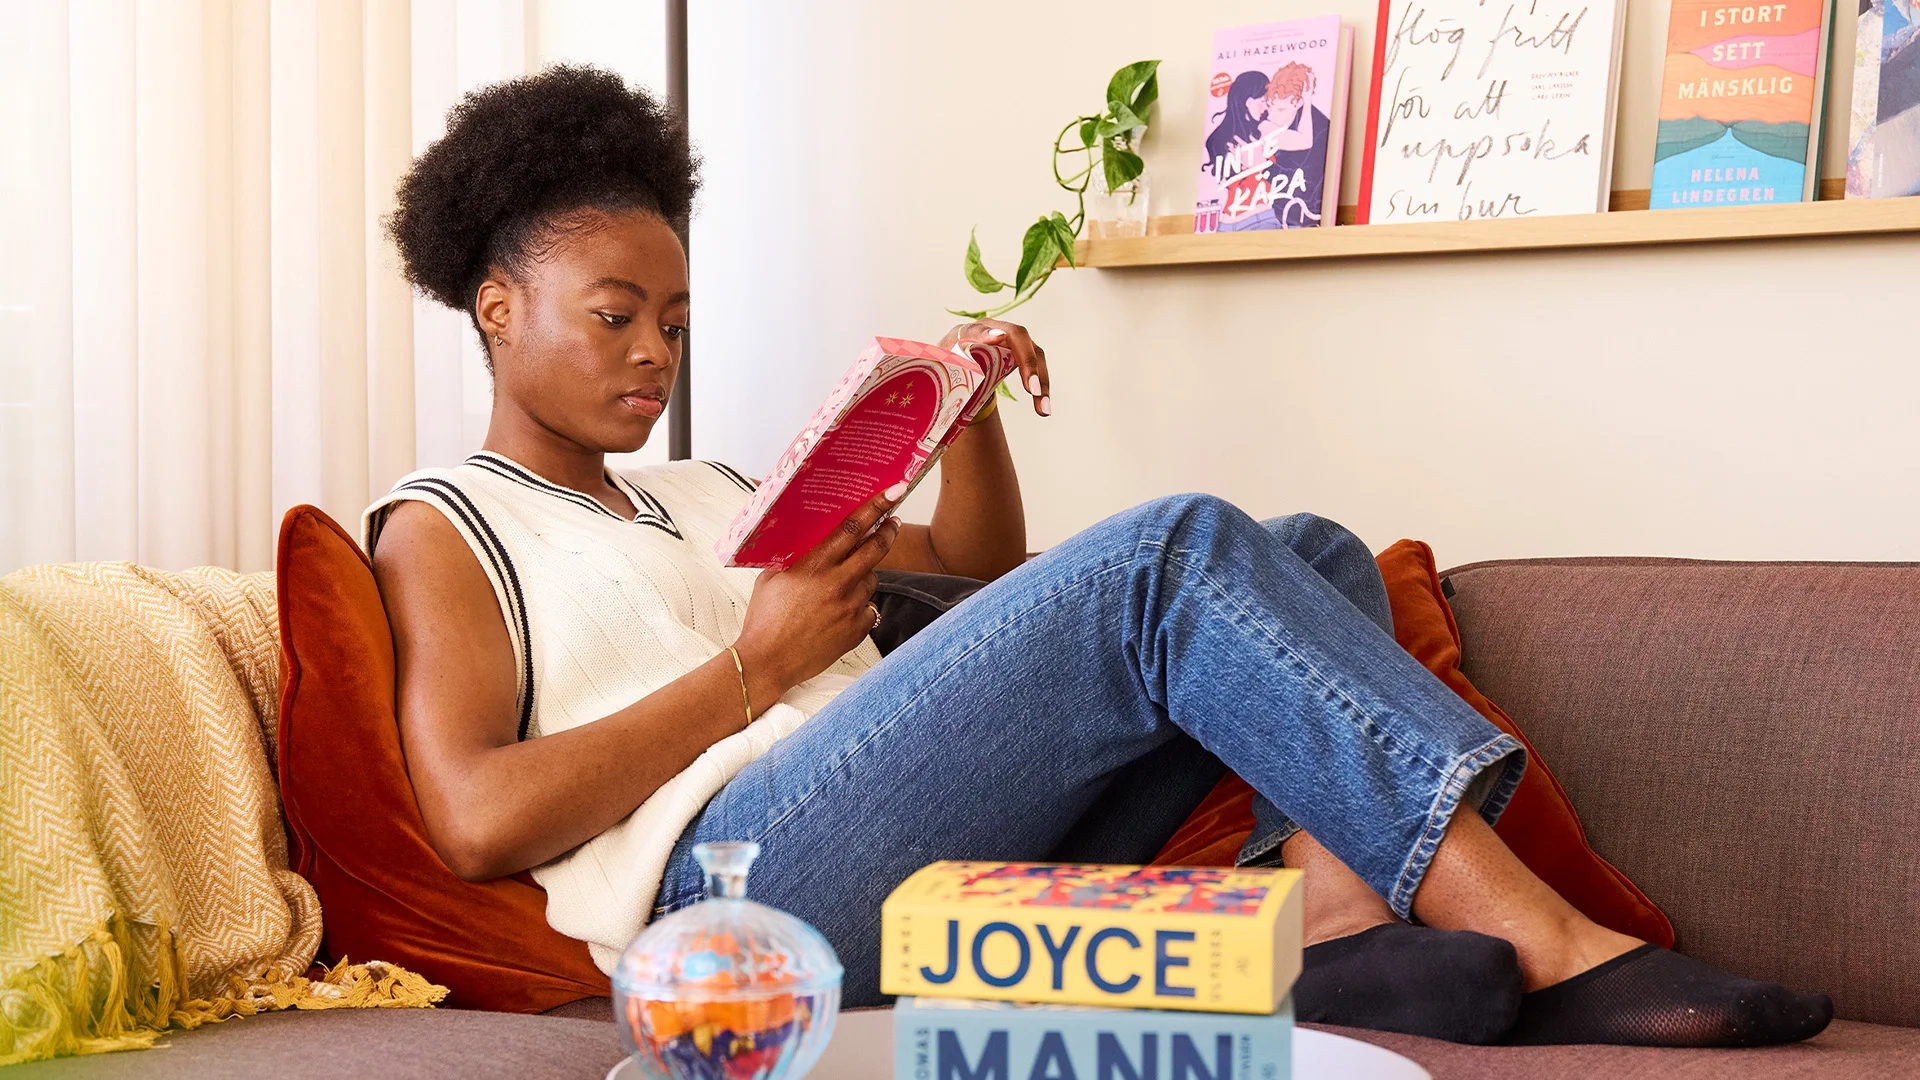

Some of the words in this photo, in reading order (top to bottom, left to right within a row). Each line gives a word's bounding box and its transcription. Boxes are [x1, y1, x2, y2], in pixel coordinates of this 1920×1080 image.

[1699, 10, 1707, 27] I
[1713, 4, 1787, 26] STORT
[1217, 50, 1237, 60] ALI
[1243, 38, 1328, 57] HAZELWOOD
[1711, 41, 1766, 62] SETT
[1677, 76, 1793, 100] MÄNSKLIG
[1381, 66, 1431, 148] för
[1454, 80, 1511, 120] att
[1214, 125, 1289, 183] INTE
[1690, 167, 1760, 184] HELENA
[1227, 167, 1306, 219] KÄRA
[1459, 180, 1538, 221] bur
[1671, 187, 1775, 204] LINDEGREN
[919, 919, 1196, 998] JOYCE
[935, 1028, 1234, 1080] MANN
